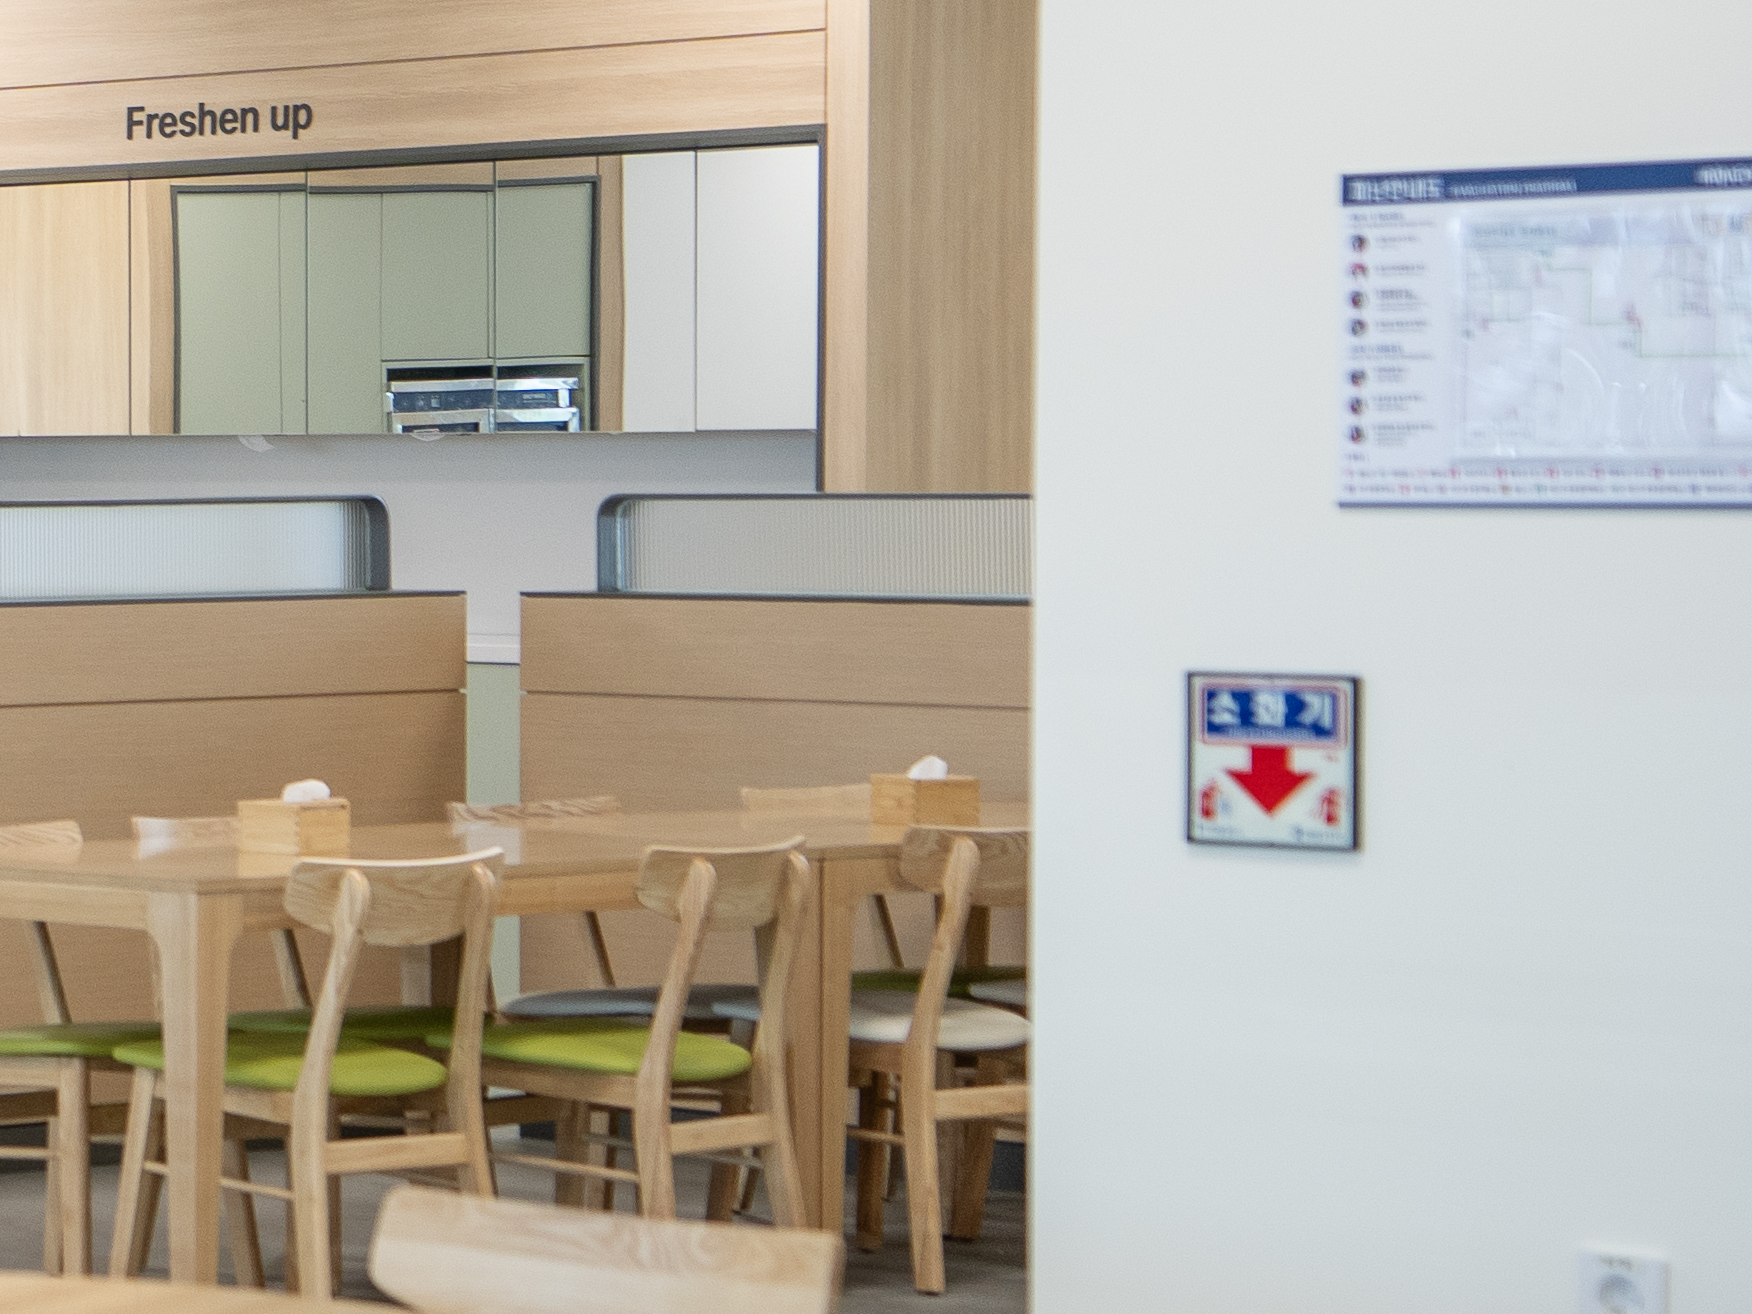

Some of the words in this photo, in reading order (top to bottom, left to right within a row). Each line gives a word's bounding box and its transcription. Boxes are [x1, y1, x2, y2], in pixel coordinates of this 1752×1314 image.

[126, 102, 260, 141] Freshen
[270, 103, 313, 140] up
[1207, 688, 1335, 728] 소화기
